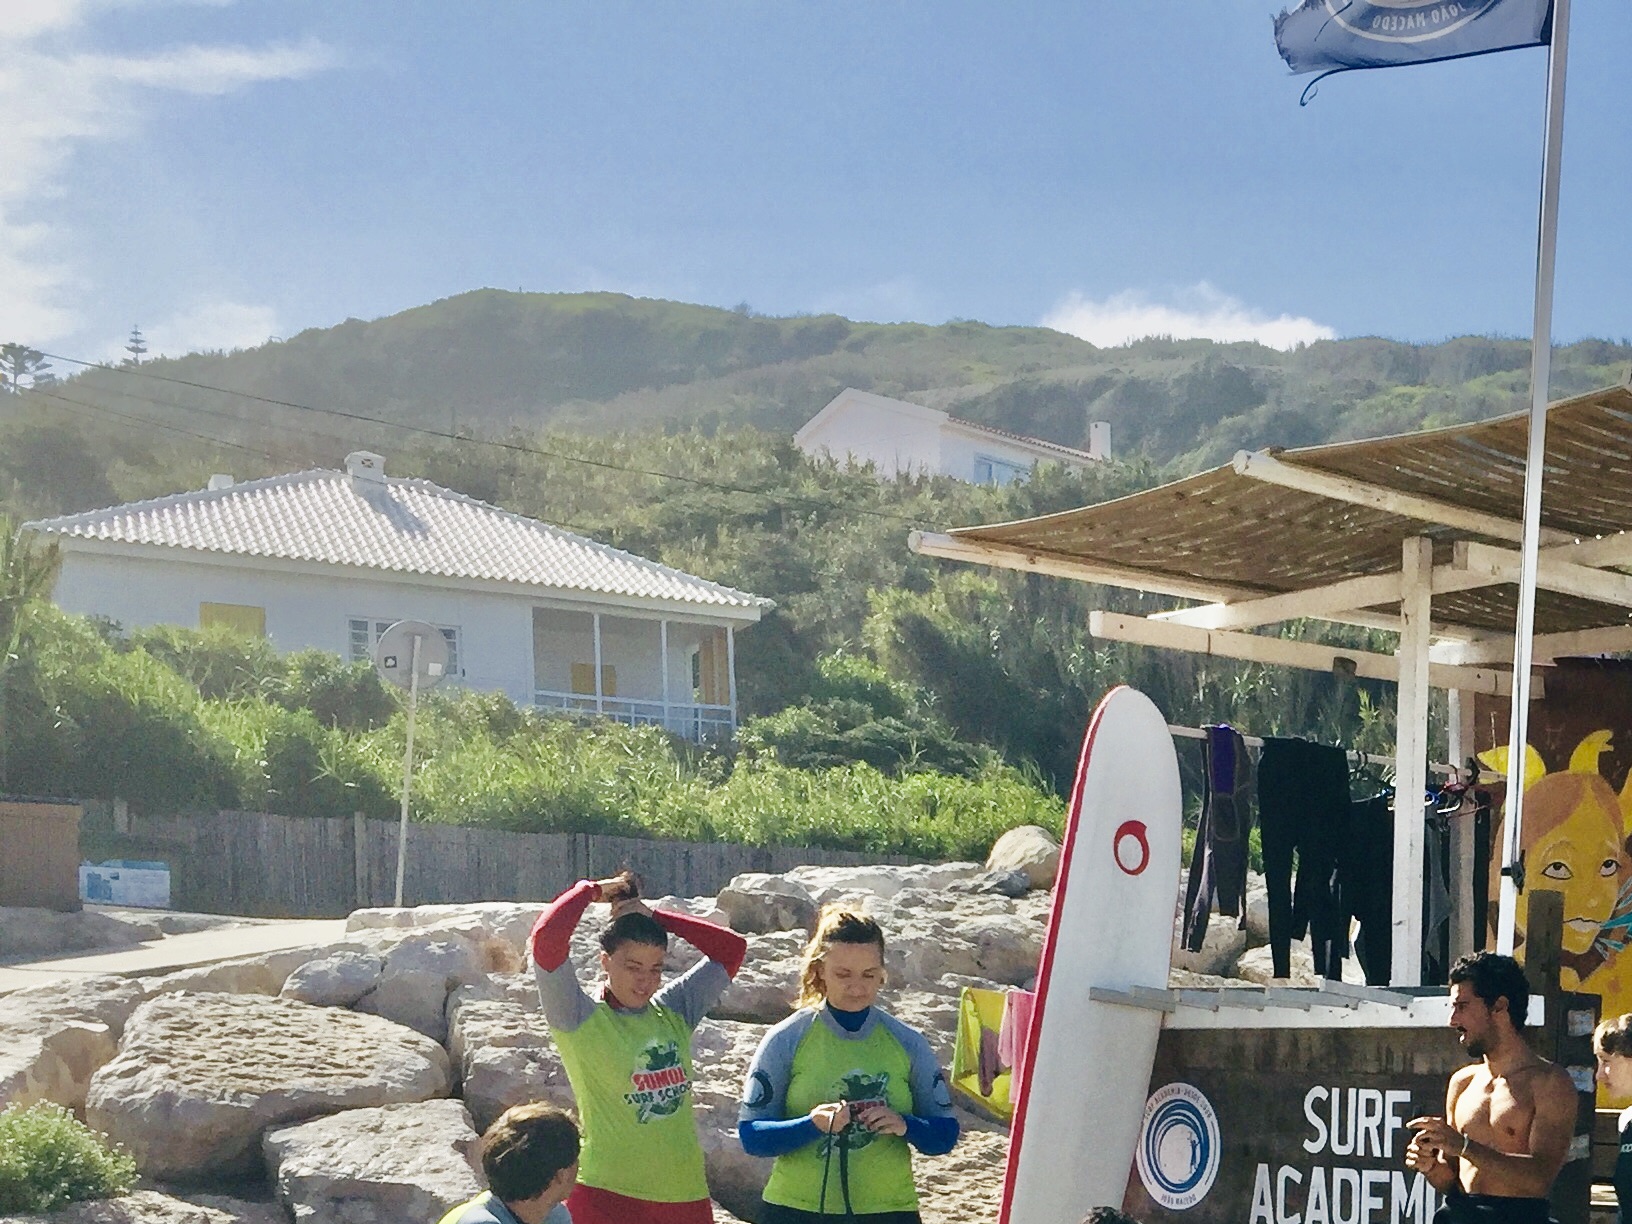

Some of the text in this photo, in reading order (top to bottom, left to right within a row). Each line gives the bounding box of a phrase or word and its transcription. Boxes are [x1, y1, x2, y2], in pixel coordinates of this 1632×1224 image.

[632, 1065, 687, 1092] SUMOL
[657, 1080, 693, 1102] SCHOO
[1302, 1084, 1412, 1159] SURF
